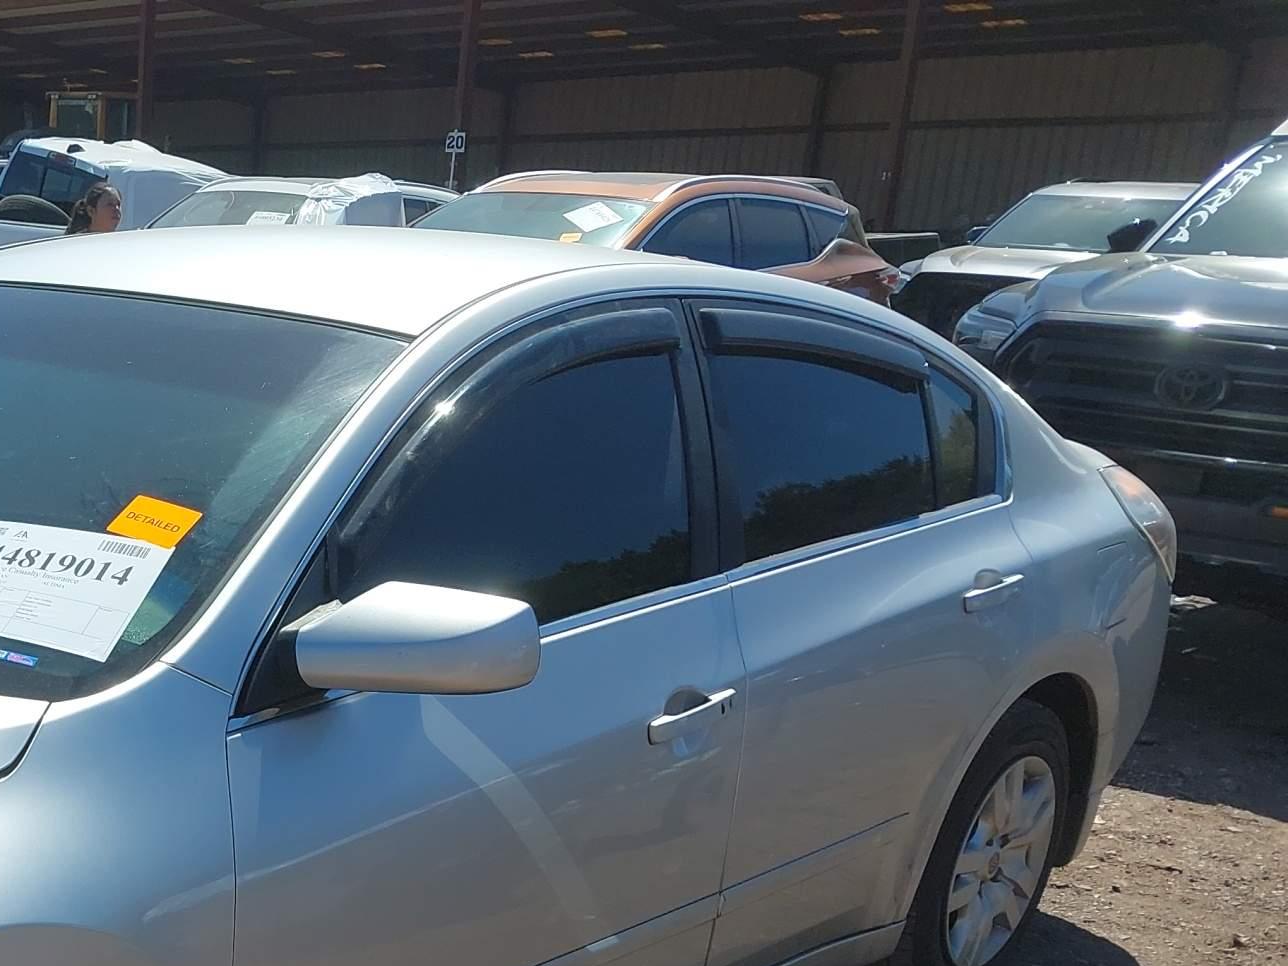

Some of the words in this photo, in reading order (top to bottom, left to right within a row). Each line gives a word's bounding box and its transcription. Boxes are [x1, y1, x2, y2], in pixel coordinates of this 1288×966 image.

[446, 135, 464, 149] 20
[125, 511, 181, 533] DETAILED
[8, 566, 40, 578] Casualty
[42, 571, 80, 584] Insurance
